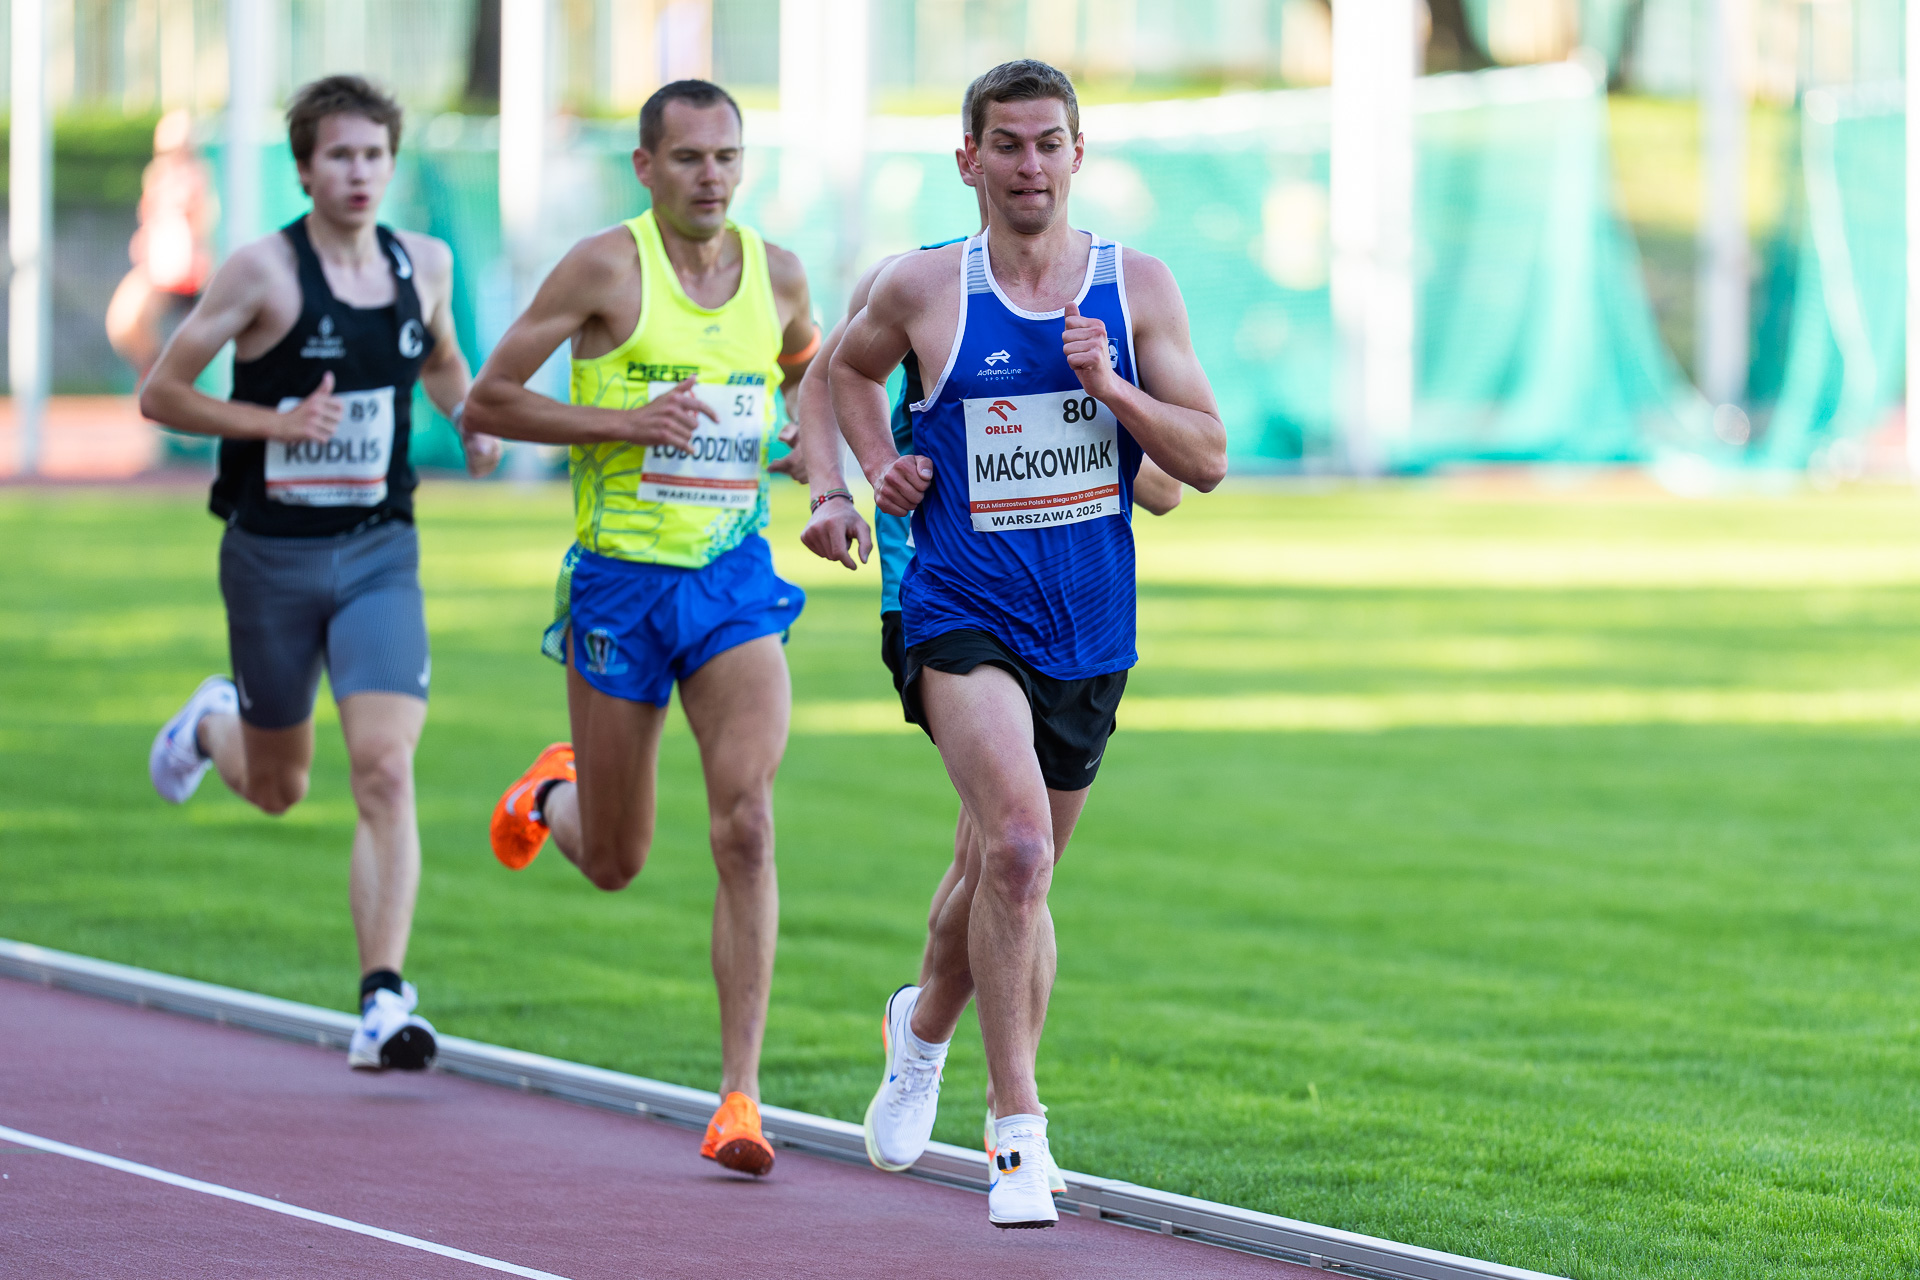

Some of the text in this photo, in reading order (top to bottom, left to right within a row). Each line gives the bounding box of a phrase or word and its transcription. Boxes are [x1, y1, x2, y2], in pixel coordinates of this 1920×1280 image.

[351, 400, 378, 422] 89
[734, 395, 754, 416] 52
[1063, 396, 1097, 423] 80
[985, 424, 1022, 435] ORLEN
[975, 440, 1113, 483] MAĆKOWIAK
[976, 502, 991, 510] PZLA
[991, 500, 1028, 509] Mistrzostwa
[1028, 498, 1046, 506] Polski
[1053, 496, 1070, 505] Biegu
[1094, 487, 1114, 496] metrów
[991, 503, 1102, 527] WARSZAWA 2025
